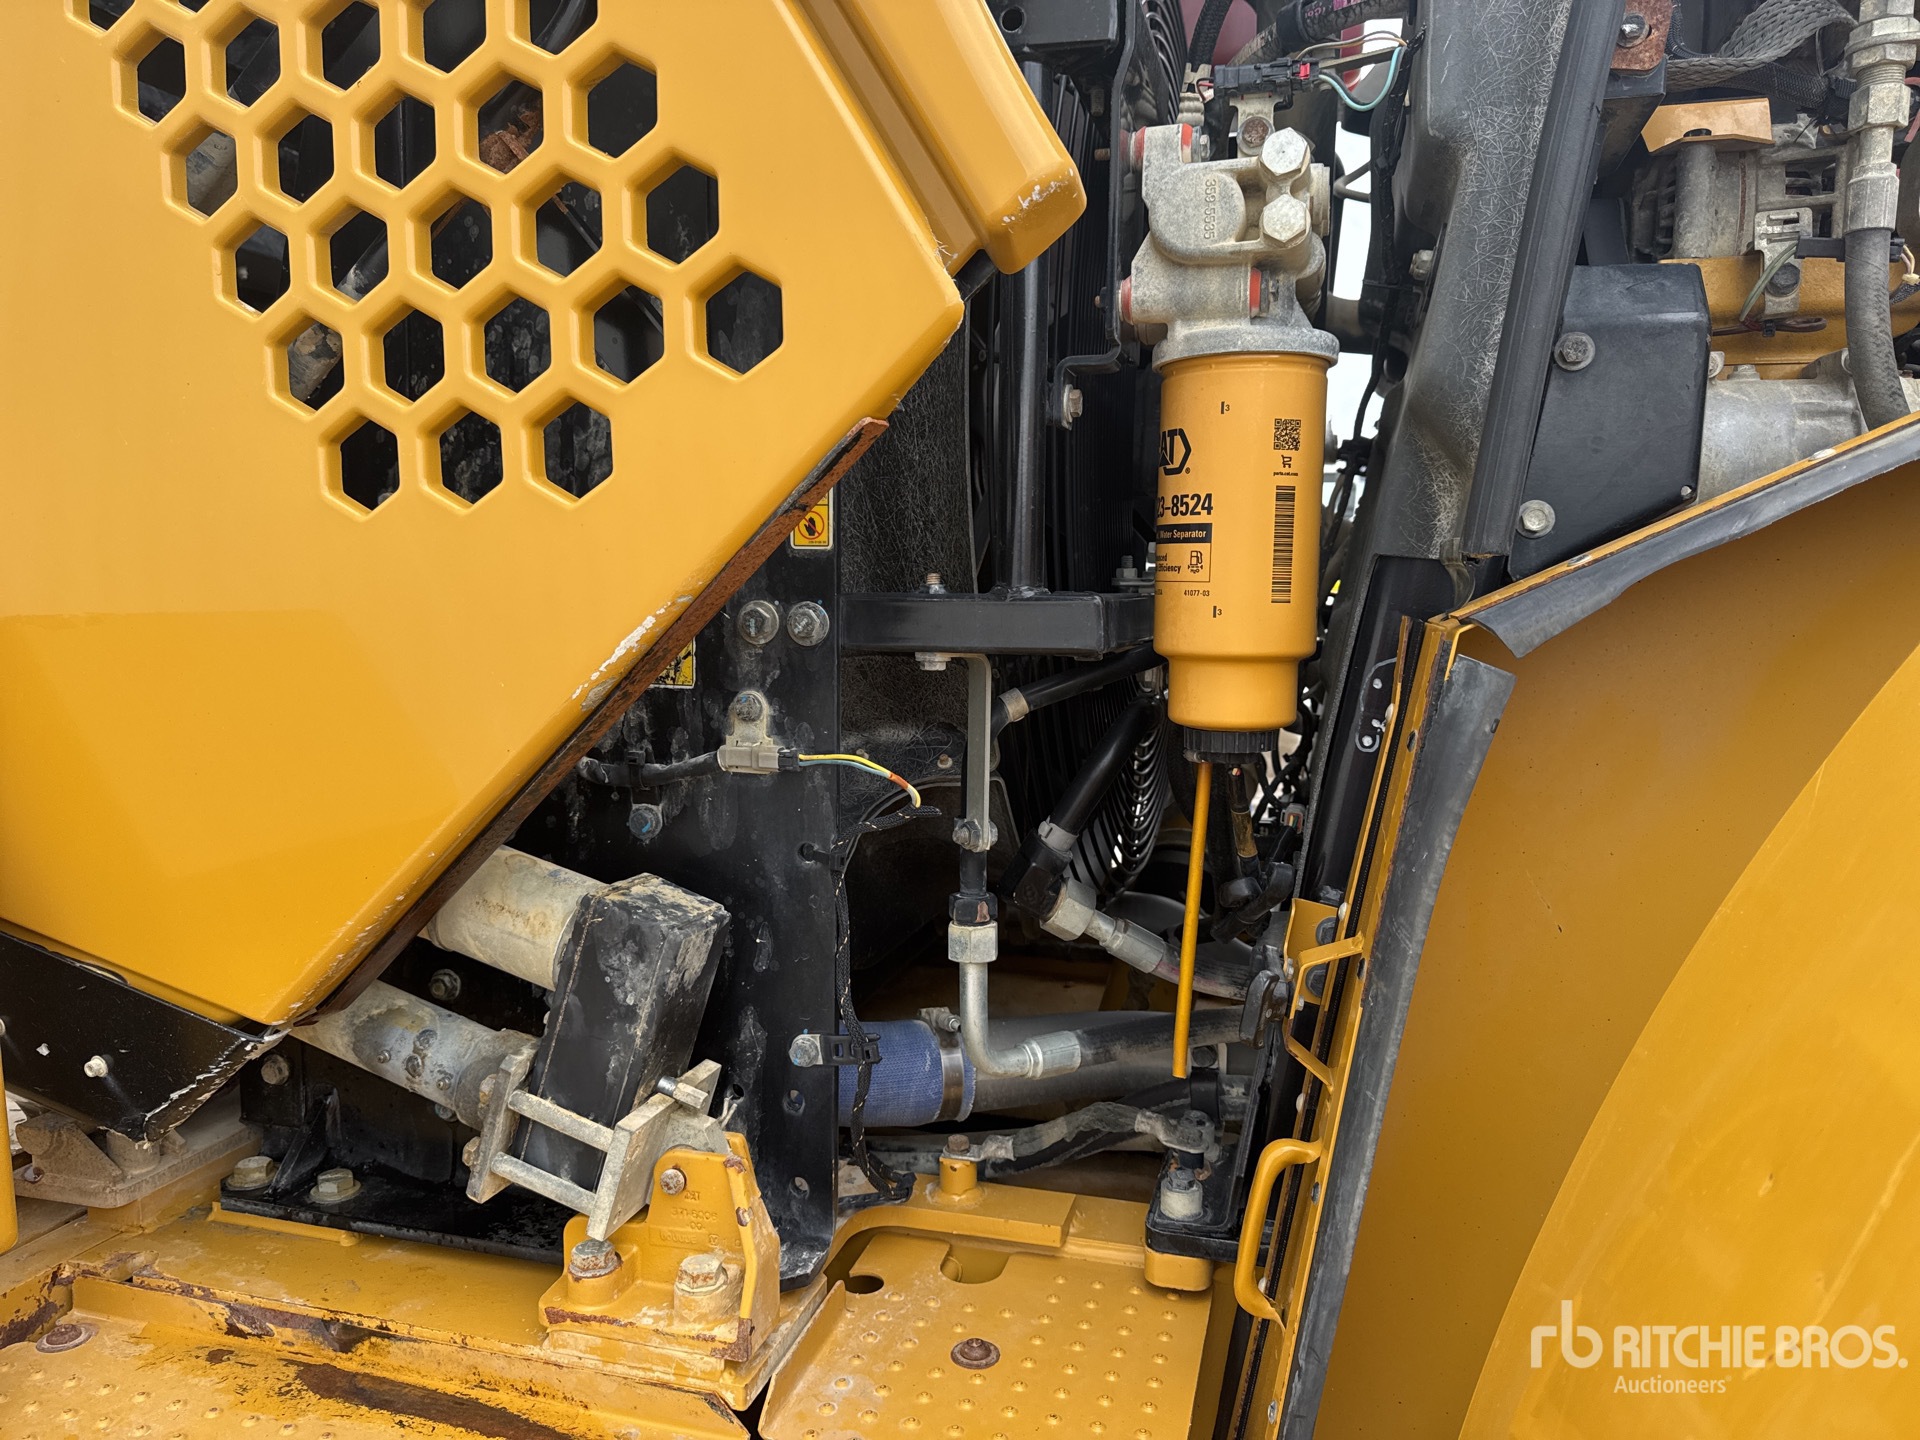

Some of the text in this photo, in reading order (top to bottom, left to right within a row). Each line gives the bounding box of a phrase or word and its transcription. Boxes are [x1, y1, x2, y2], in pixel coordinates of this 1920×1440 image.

[1157, 492, 1214, 518] 23-8524
[1173, 529, 1207, 540] Separator
[1184, 589, 1210, 597] 41077-03
